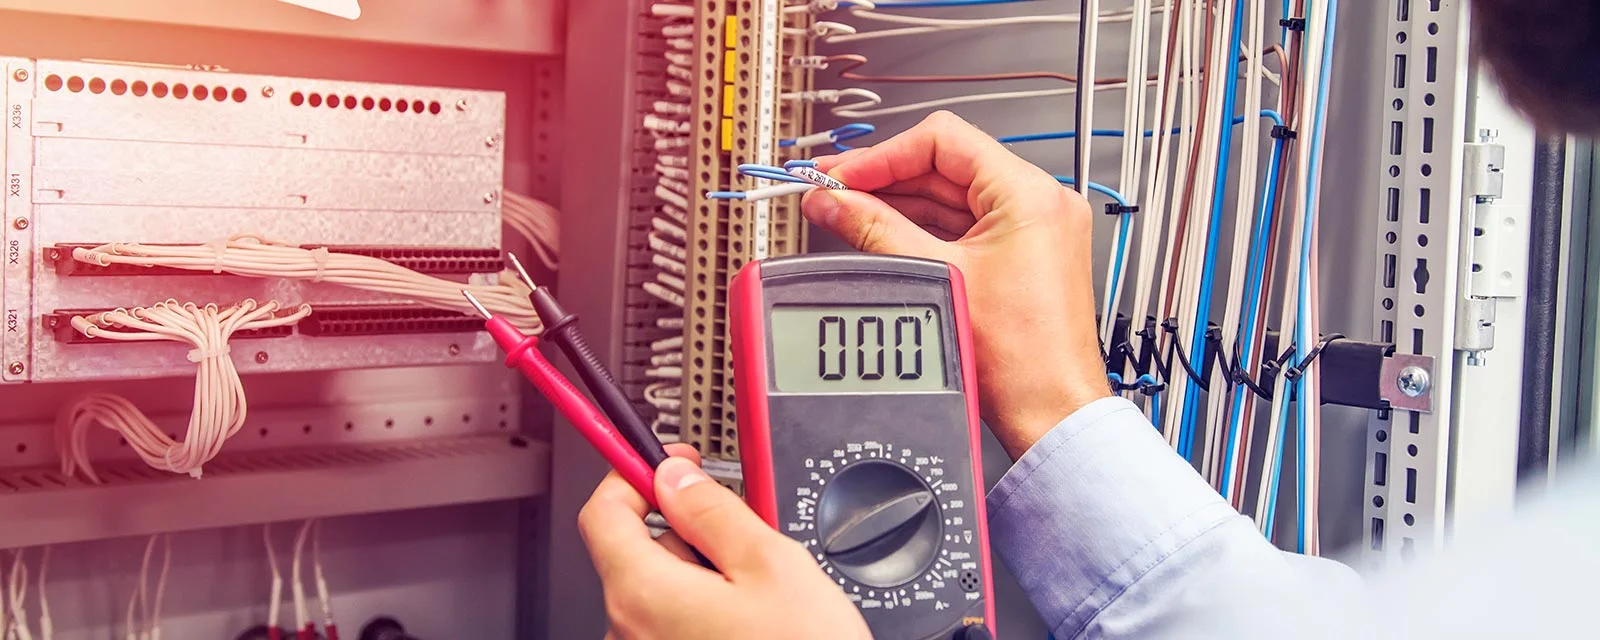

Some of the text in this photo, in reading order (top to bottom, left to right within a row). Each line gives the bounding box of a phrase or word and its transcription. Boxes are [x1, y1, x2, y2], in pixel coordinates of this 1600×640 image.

[12, 104, 22, 129] X336
[11, 173, 20, 197] X331
[9, 240, 18, 264] X326
[8, 308, 17, 333] X321
[819, 316, 922, 380] 000
